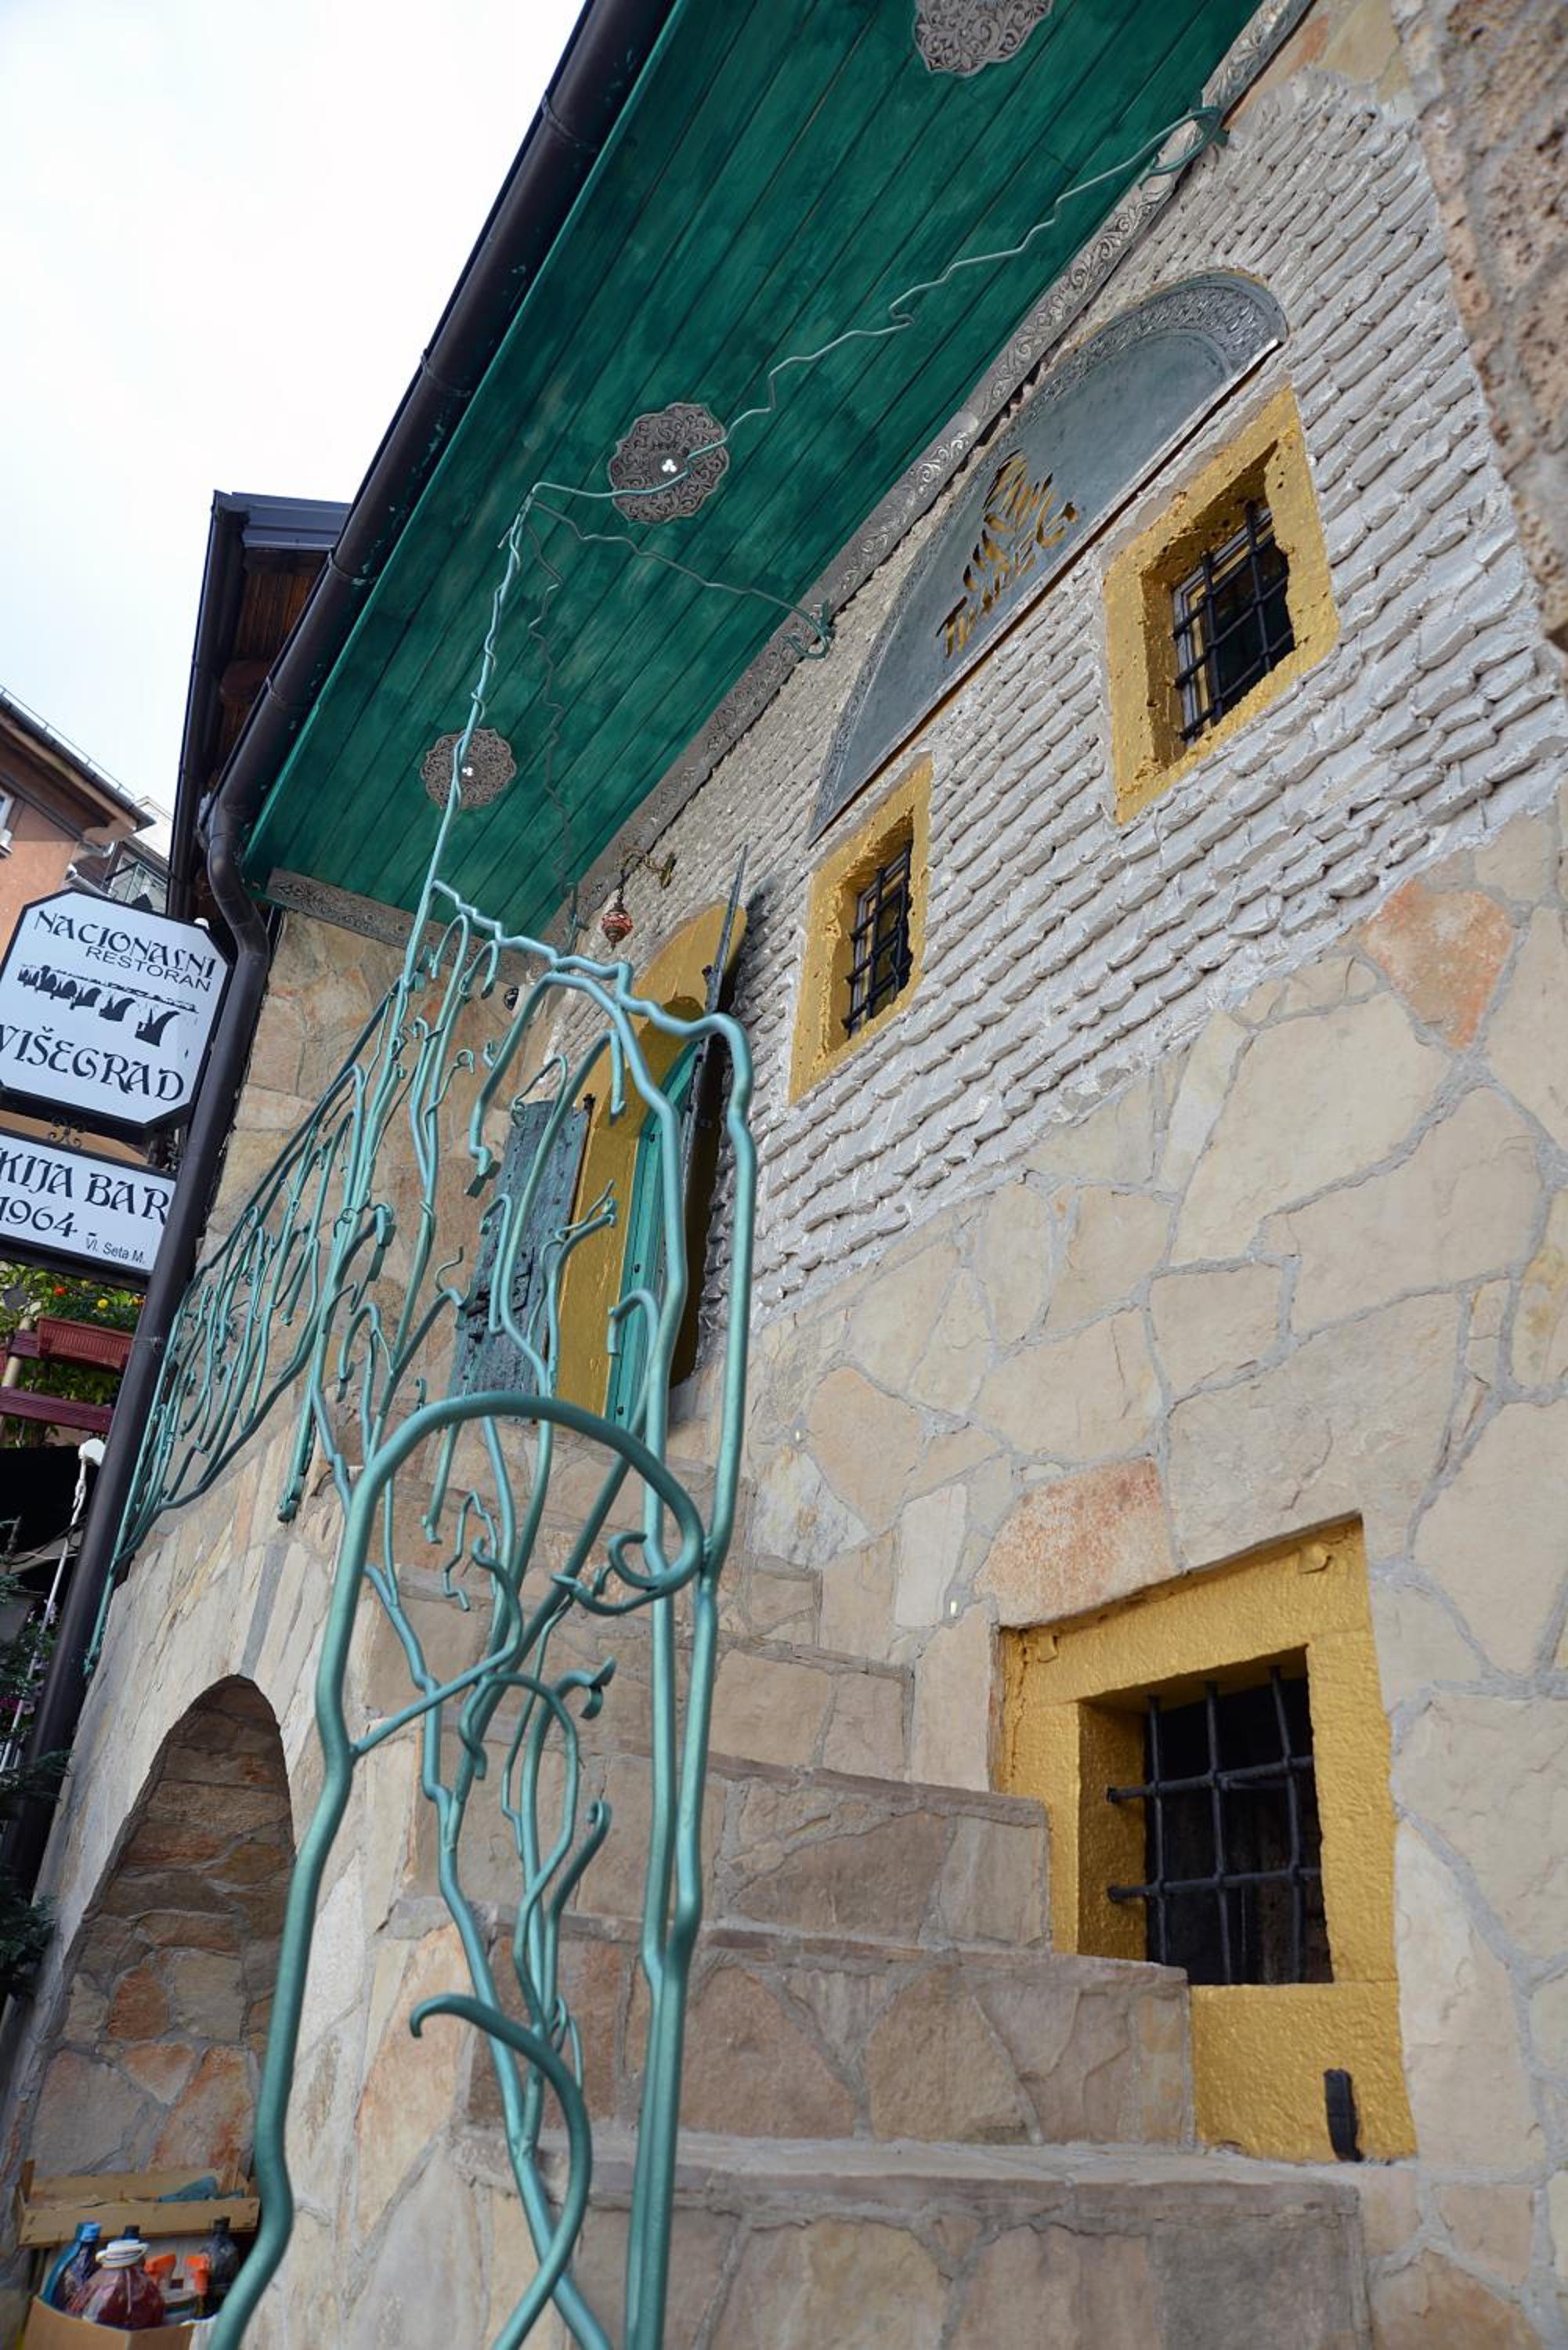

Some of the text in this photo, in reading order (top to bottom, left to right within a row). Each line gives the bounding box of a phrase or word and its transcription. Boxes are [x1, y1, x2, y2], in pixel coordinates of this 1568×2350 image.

[34, 910, 216, 979] NACIONALNI
[85, 945, 211, 992] RESTORAN
[0, 1024, 185, 1101] VIŠEGRAD
[84, 1173, 169, 1226] BAR
[103, 1242, 129, 1260] Seta
